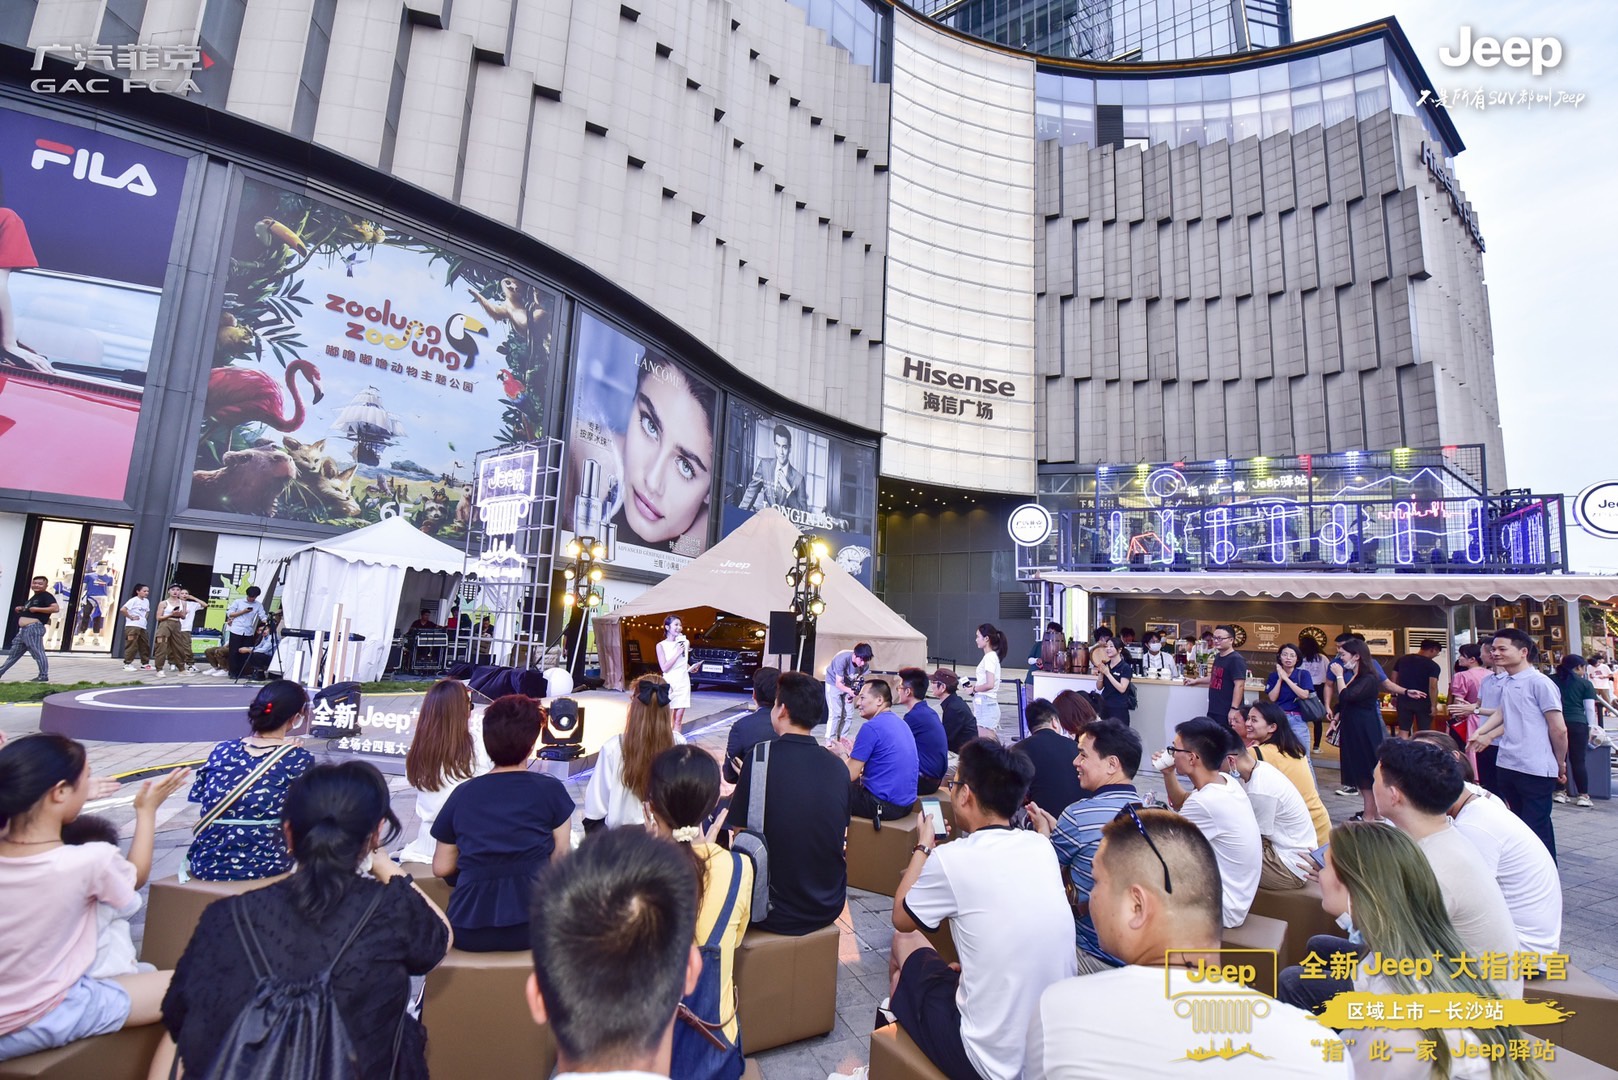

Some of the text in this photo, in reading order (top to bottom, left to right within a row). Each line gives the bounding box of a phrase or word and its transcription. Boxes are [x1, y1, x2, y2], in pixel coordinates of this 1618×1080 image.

[31, 139, 157, 196] FILA
[325, 345, 474, 393] 嘟噜嘟噜动物主题公园
[903, 357, 1015, 396] Hisense
[923, 391, 993, 420] 海信广场
[488, 466, 524, 491] Jeep
[380, 501, 414, 521] 6F
[1598, 499, 1618, 508] Je
[720, 560, 751, 569] Jeep
[338, 737, 411, 755] 全场合四驱大
